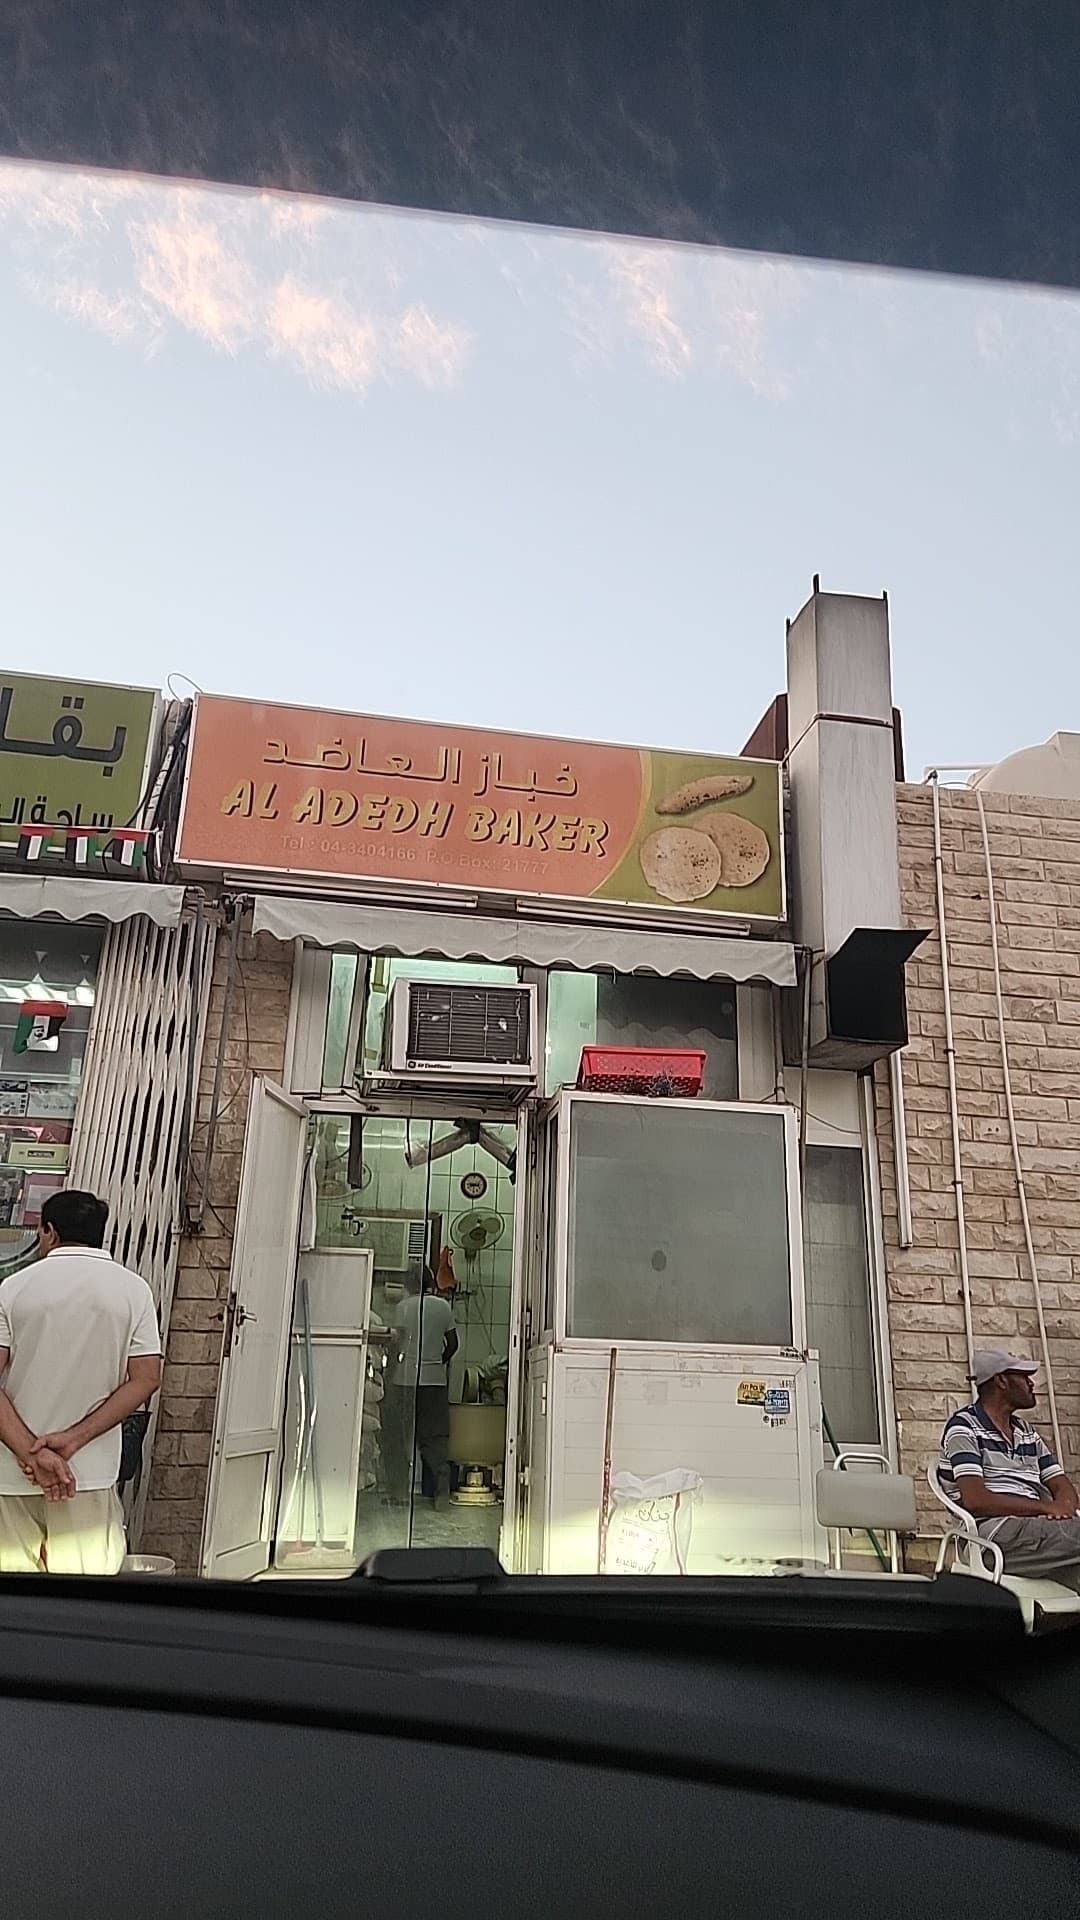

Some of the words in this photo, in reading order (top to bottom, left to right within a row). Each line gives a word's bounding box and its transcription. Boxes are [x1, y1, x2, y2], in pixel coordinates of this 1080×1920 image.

[0, 687, 127, 777] بقا
[264, 736, 461, 785] العاضد
[474, 751, 578, 802] خباز
[221, 779, 279, 820] AL
[291, 786, 455, 838] ADEDH
[464, 804, 609, 858] BAKER
[320, 839, 416, 861] 04-3404166
[503, 858, 548, 874] 21777
